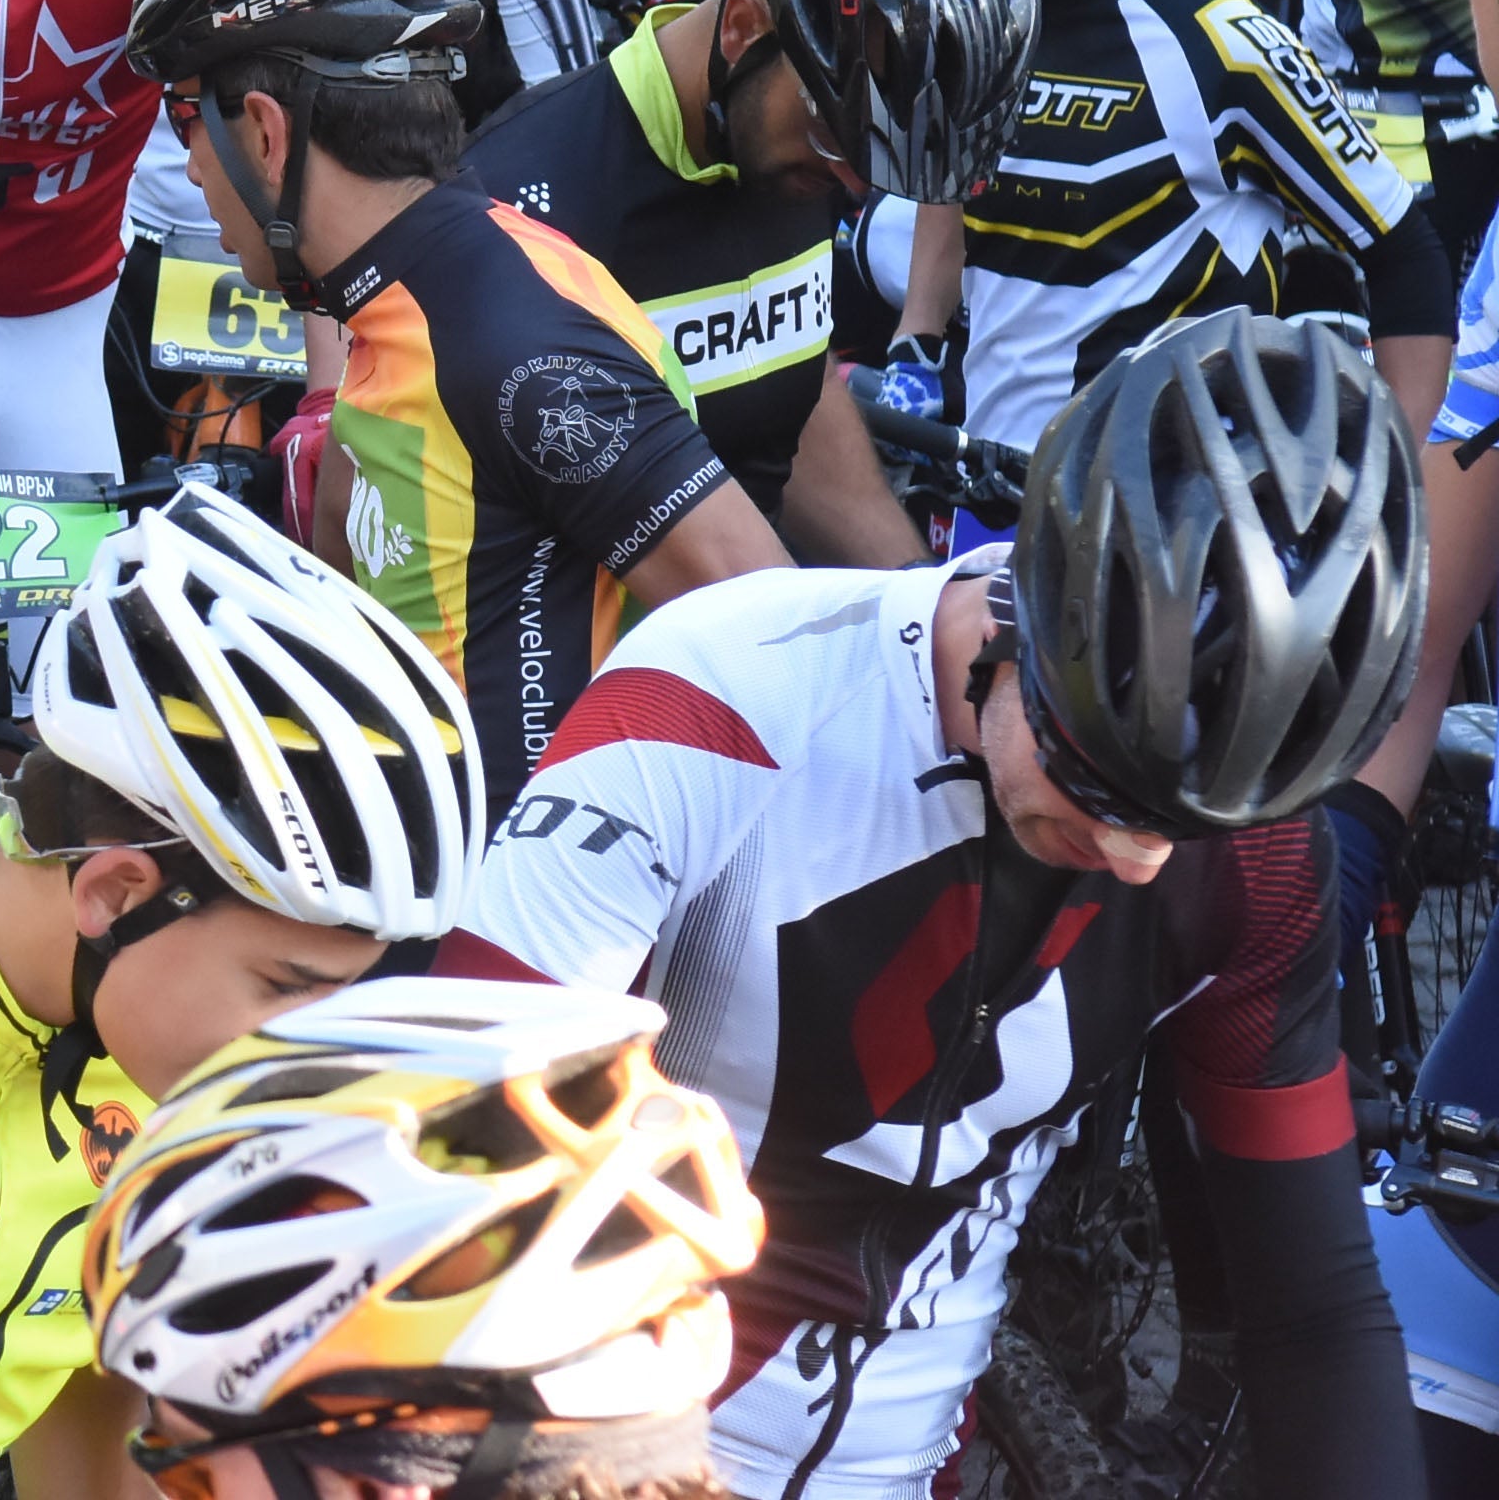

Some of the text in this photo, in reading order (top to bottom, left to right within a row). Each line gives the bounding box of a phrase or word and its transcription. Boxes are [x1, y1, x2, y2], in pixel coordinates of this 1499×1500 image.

[1019, 79, 1133, 123] OTT
[1236, 16, 1376, 164] SCOTT
[343, 264, 378, 299] DIEM
[182, 349, 247, 368] sopharma
[673, 283, 809, 367] CRAFT
[498, 355, 598, 428] ВЕЛОКЛУБ
[559, 416, 635, 485] МАМУТ
[15, 474, 56, 498] ВРЪХ
[278, 790, 329, 894] SCOTT
